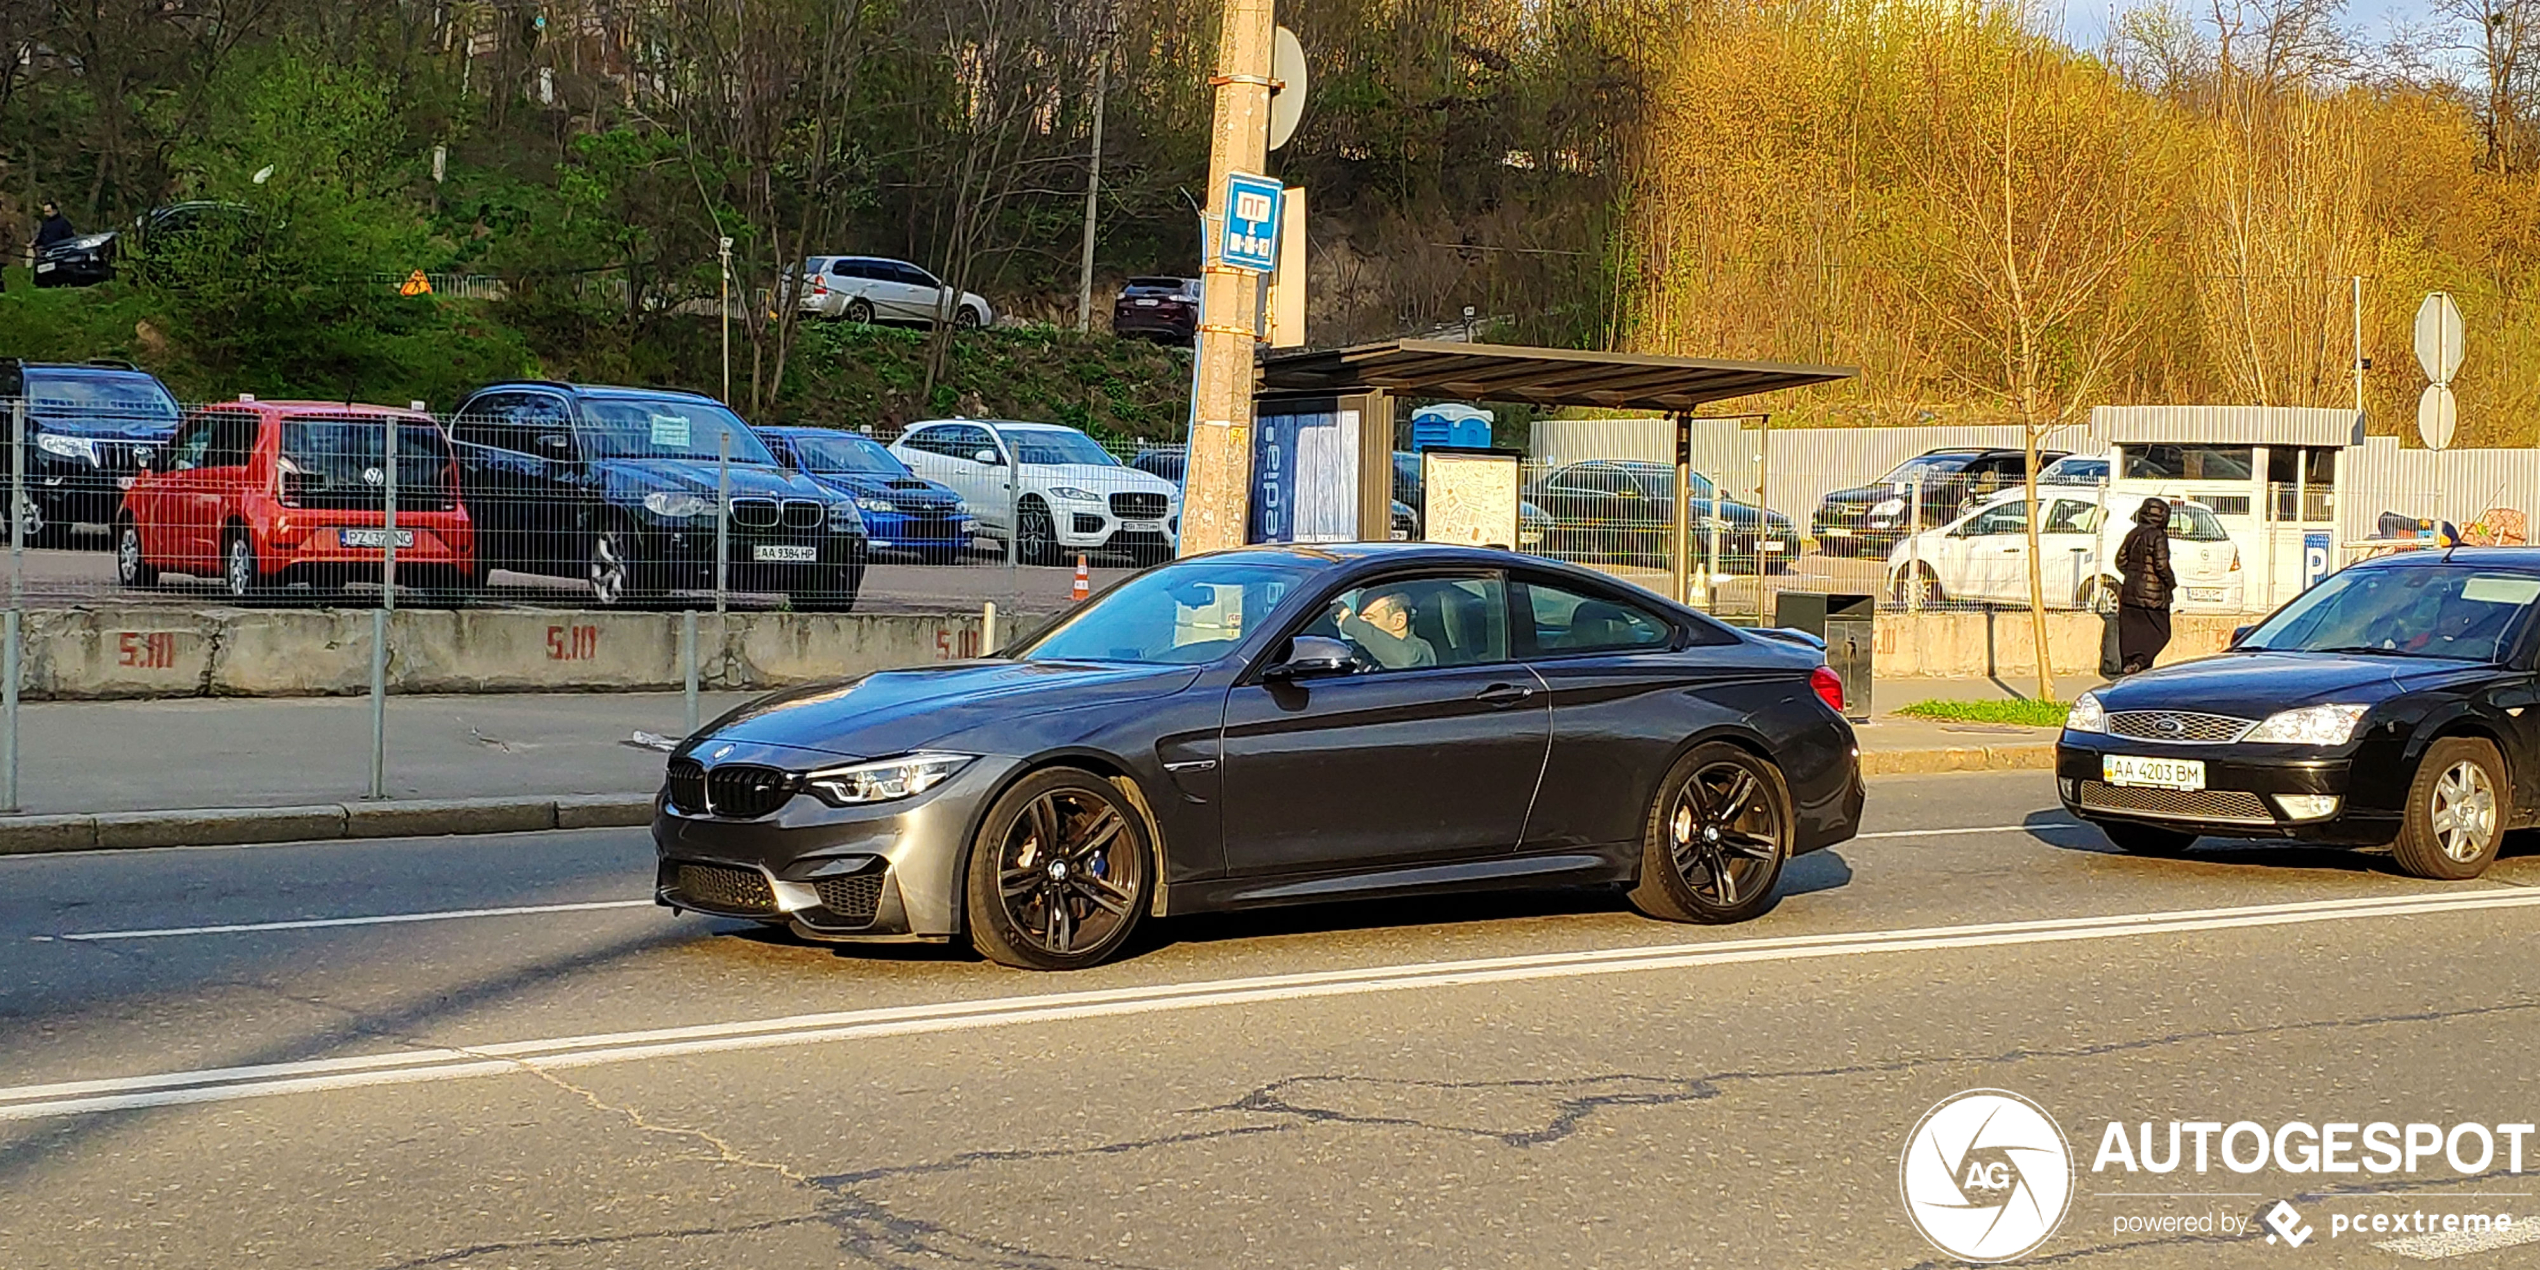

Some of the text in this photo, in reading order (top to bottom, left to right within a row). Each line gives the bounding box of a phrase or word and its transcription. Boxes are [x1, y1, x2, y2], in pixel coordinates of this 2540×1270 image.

[1241, 196, 1266, 218] ПГ
[348, 530, 367, 544] PZ
[761, 547, 815, 560] AA 9384 HP
[2305, 547, 2328, 590] P
[2113, 760, 2199, 783] AA 4203 BM
